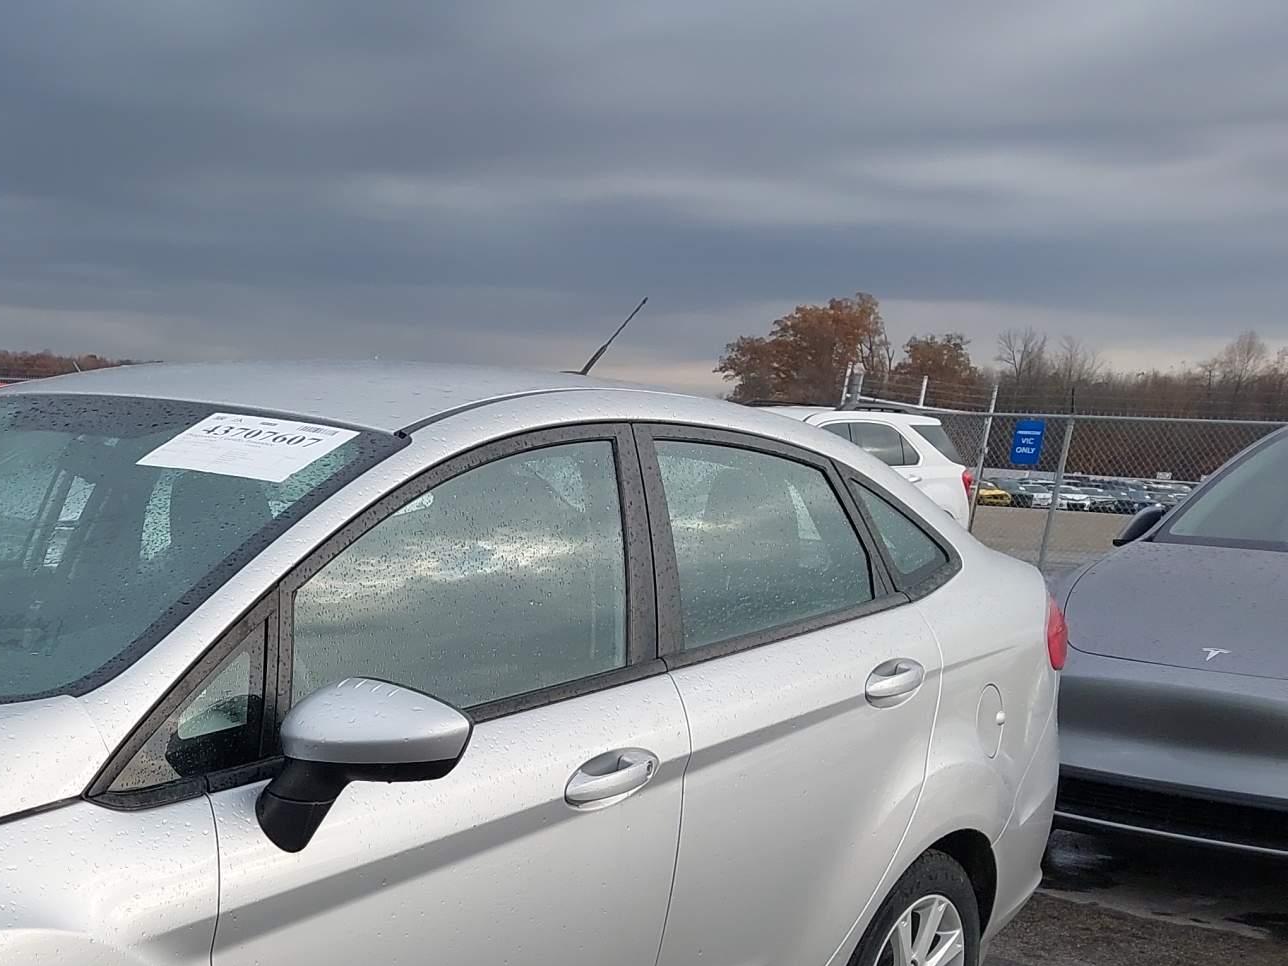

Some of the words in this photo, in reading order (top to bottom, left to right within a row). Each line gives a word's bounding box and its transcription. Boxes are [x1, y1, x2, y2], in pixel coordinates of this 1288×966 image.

[202, 425, 324, 448] 43707607
[1021, 437, 1035, 445] VIC
[1015, 446, 1036, 454] ONLY
